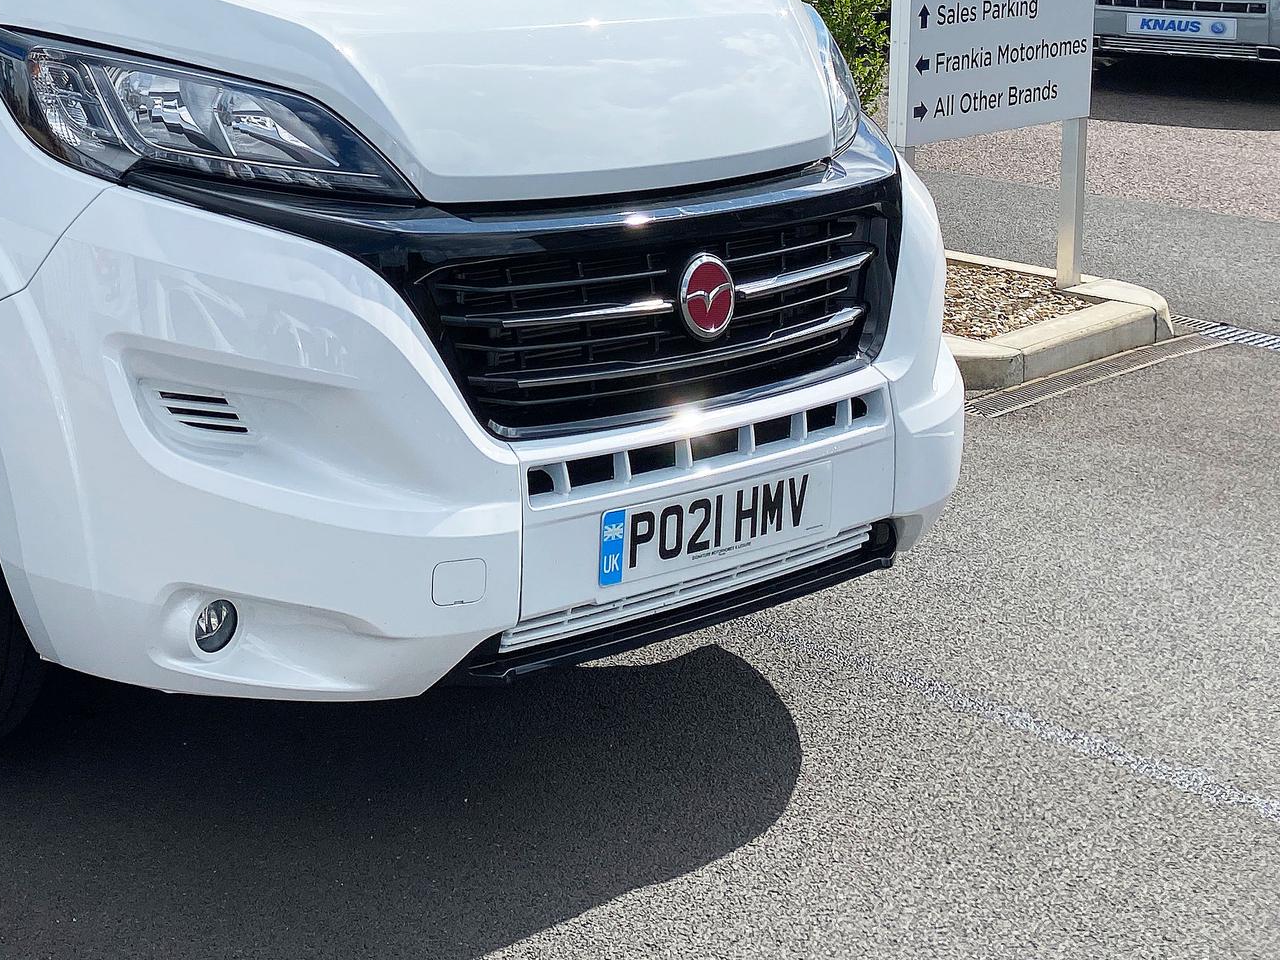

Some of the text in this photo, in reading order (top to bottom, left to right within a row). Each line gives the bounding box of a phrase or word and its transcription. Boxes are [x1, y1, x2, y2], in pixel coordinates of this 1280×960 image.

[936, 2, 977, 26] Sales
[1140, 18, 1202, 33] KNAUS
[935, 38, 1087, 74] Frankia Motorhomes
[933, 80, 1058, 118] All Other Brands
[628, 474, 809, 569] PO21 HMV
[603, 552, 620, 574] UK
